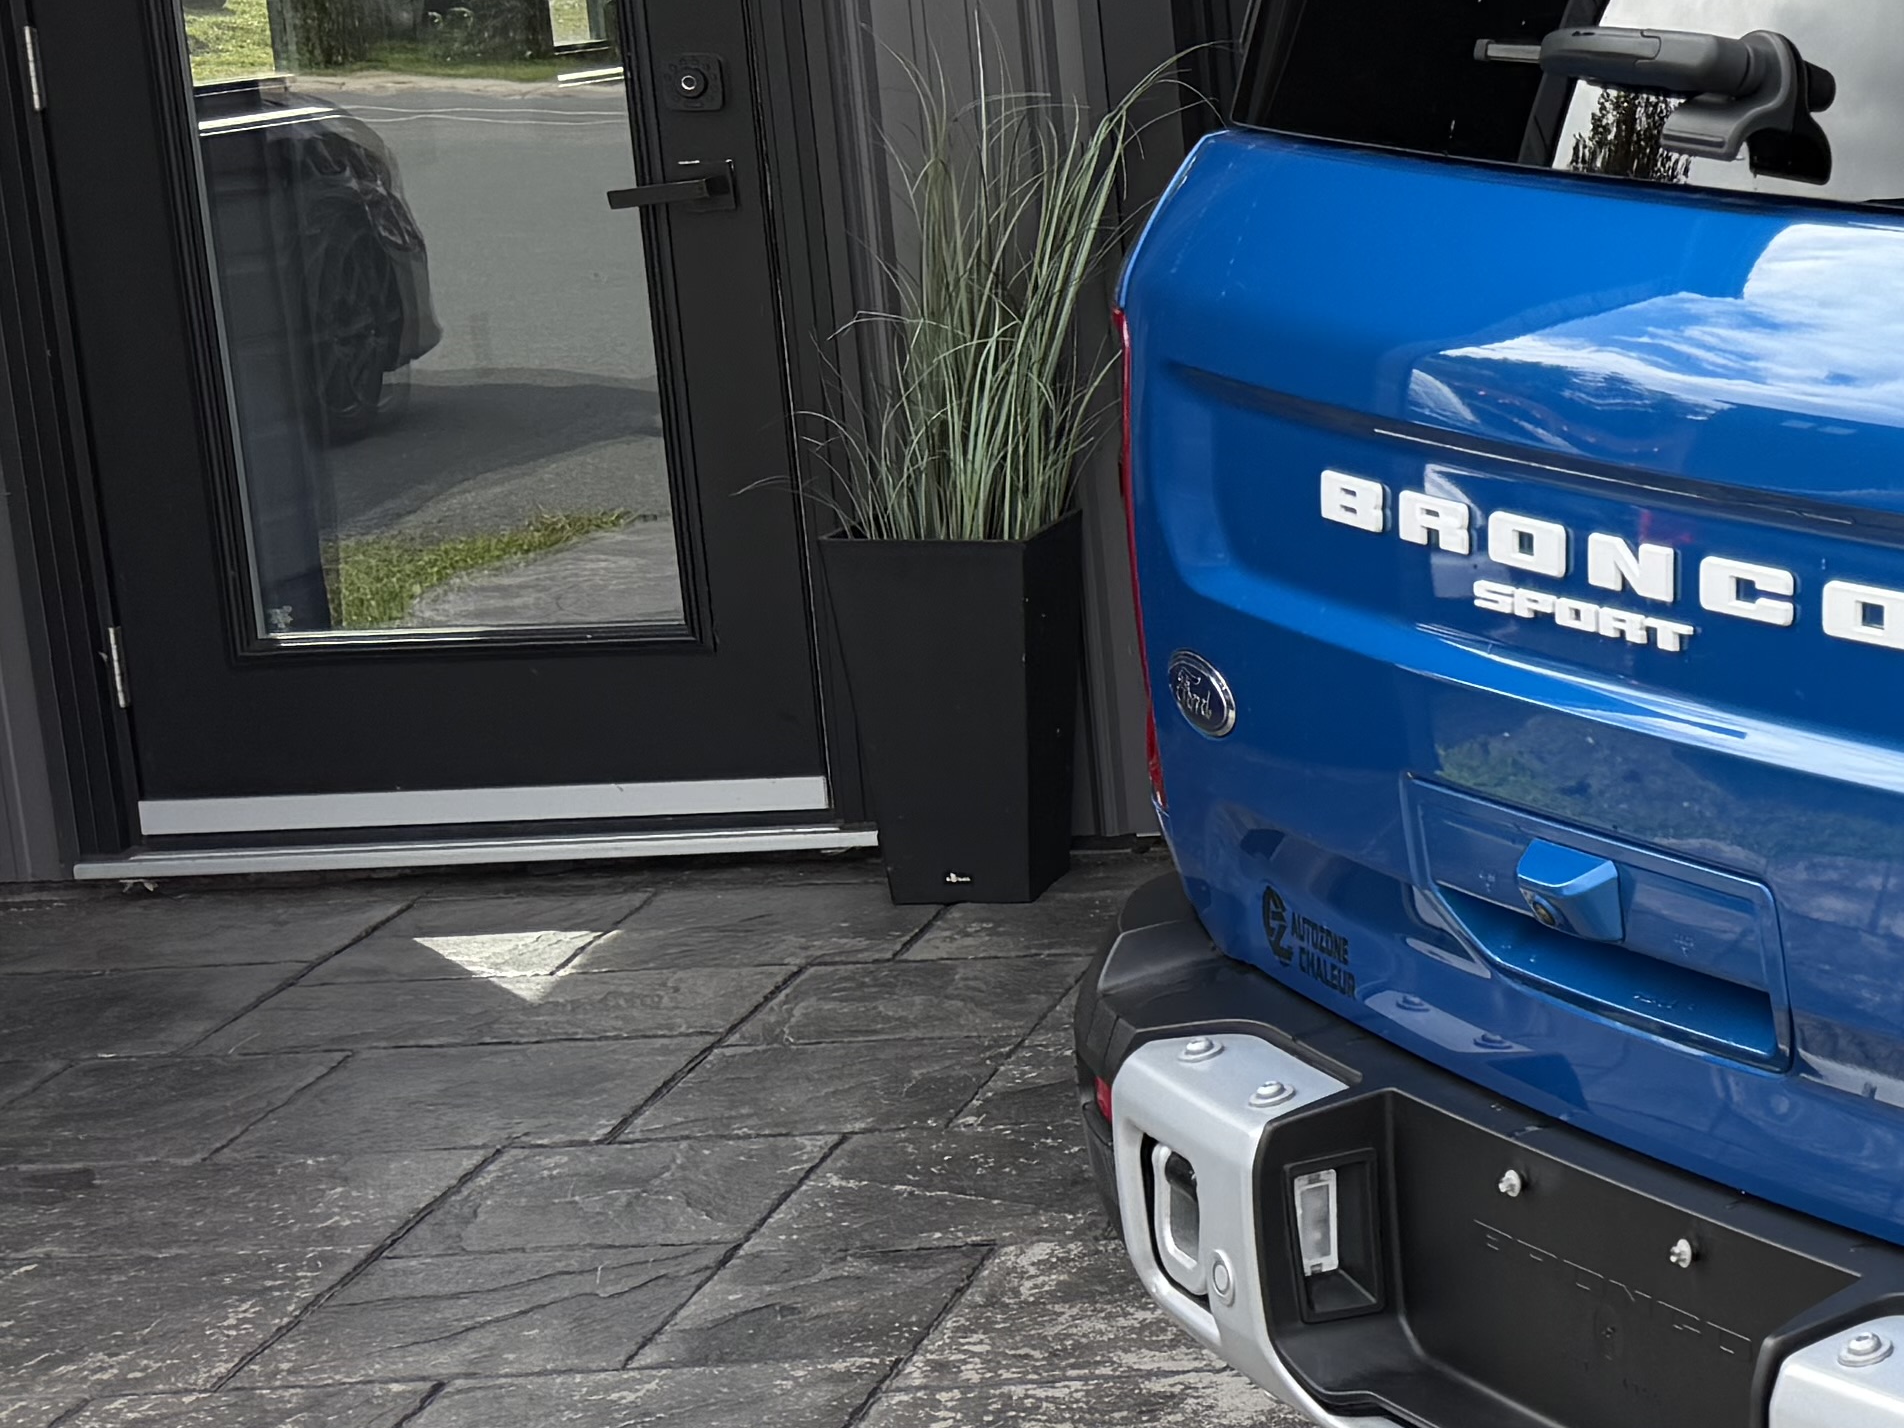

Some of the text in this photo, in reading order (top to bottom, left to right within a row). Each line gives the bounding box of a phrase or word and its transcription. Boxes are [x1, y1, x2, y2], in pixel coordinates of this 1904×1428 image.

[1473, 579, 1695, 652] SPORT
[1175, 666, 1213, 721] Ford
[1291, 910, 1349, 966] AUTOZONE
[1298, 946, 1357, 1001] CHALEUR
